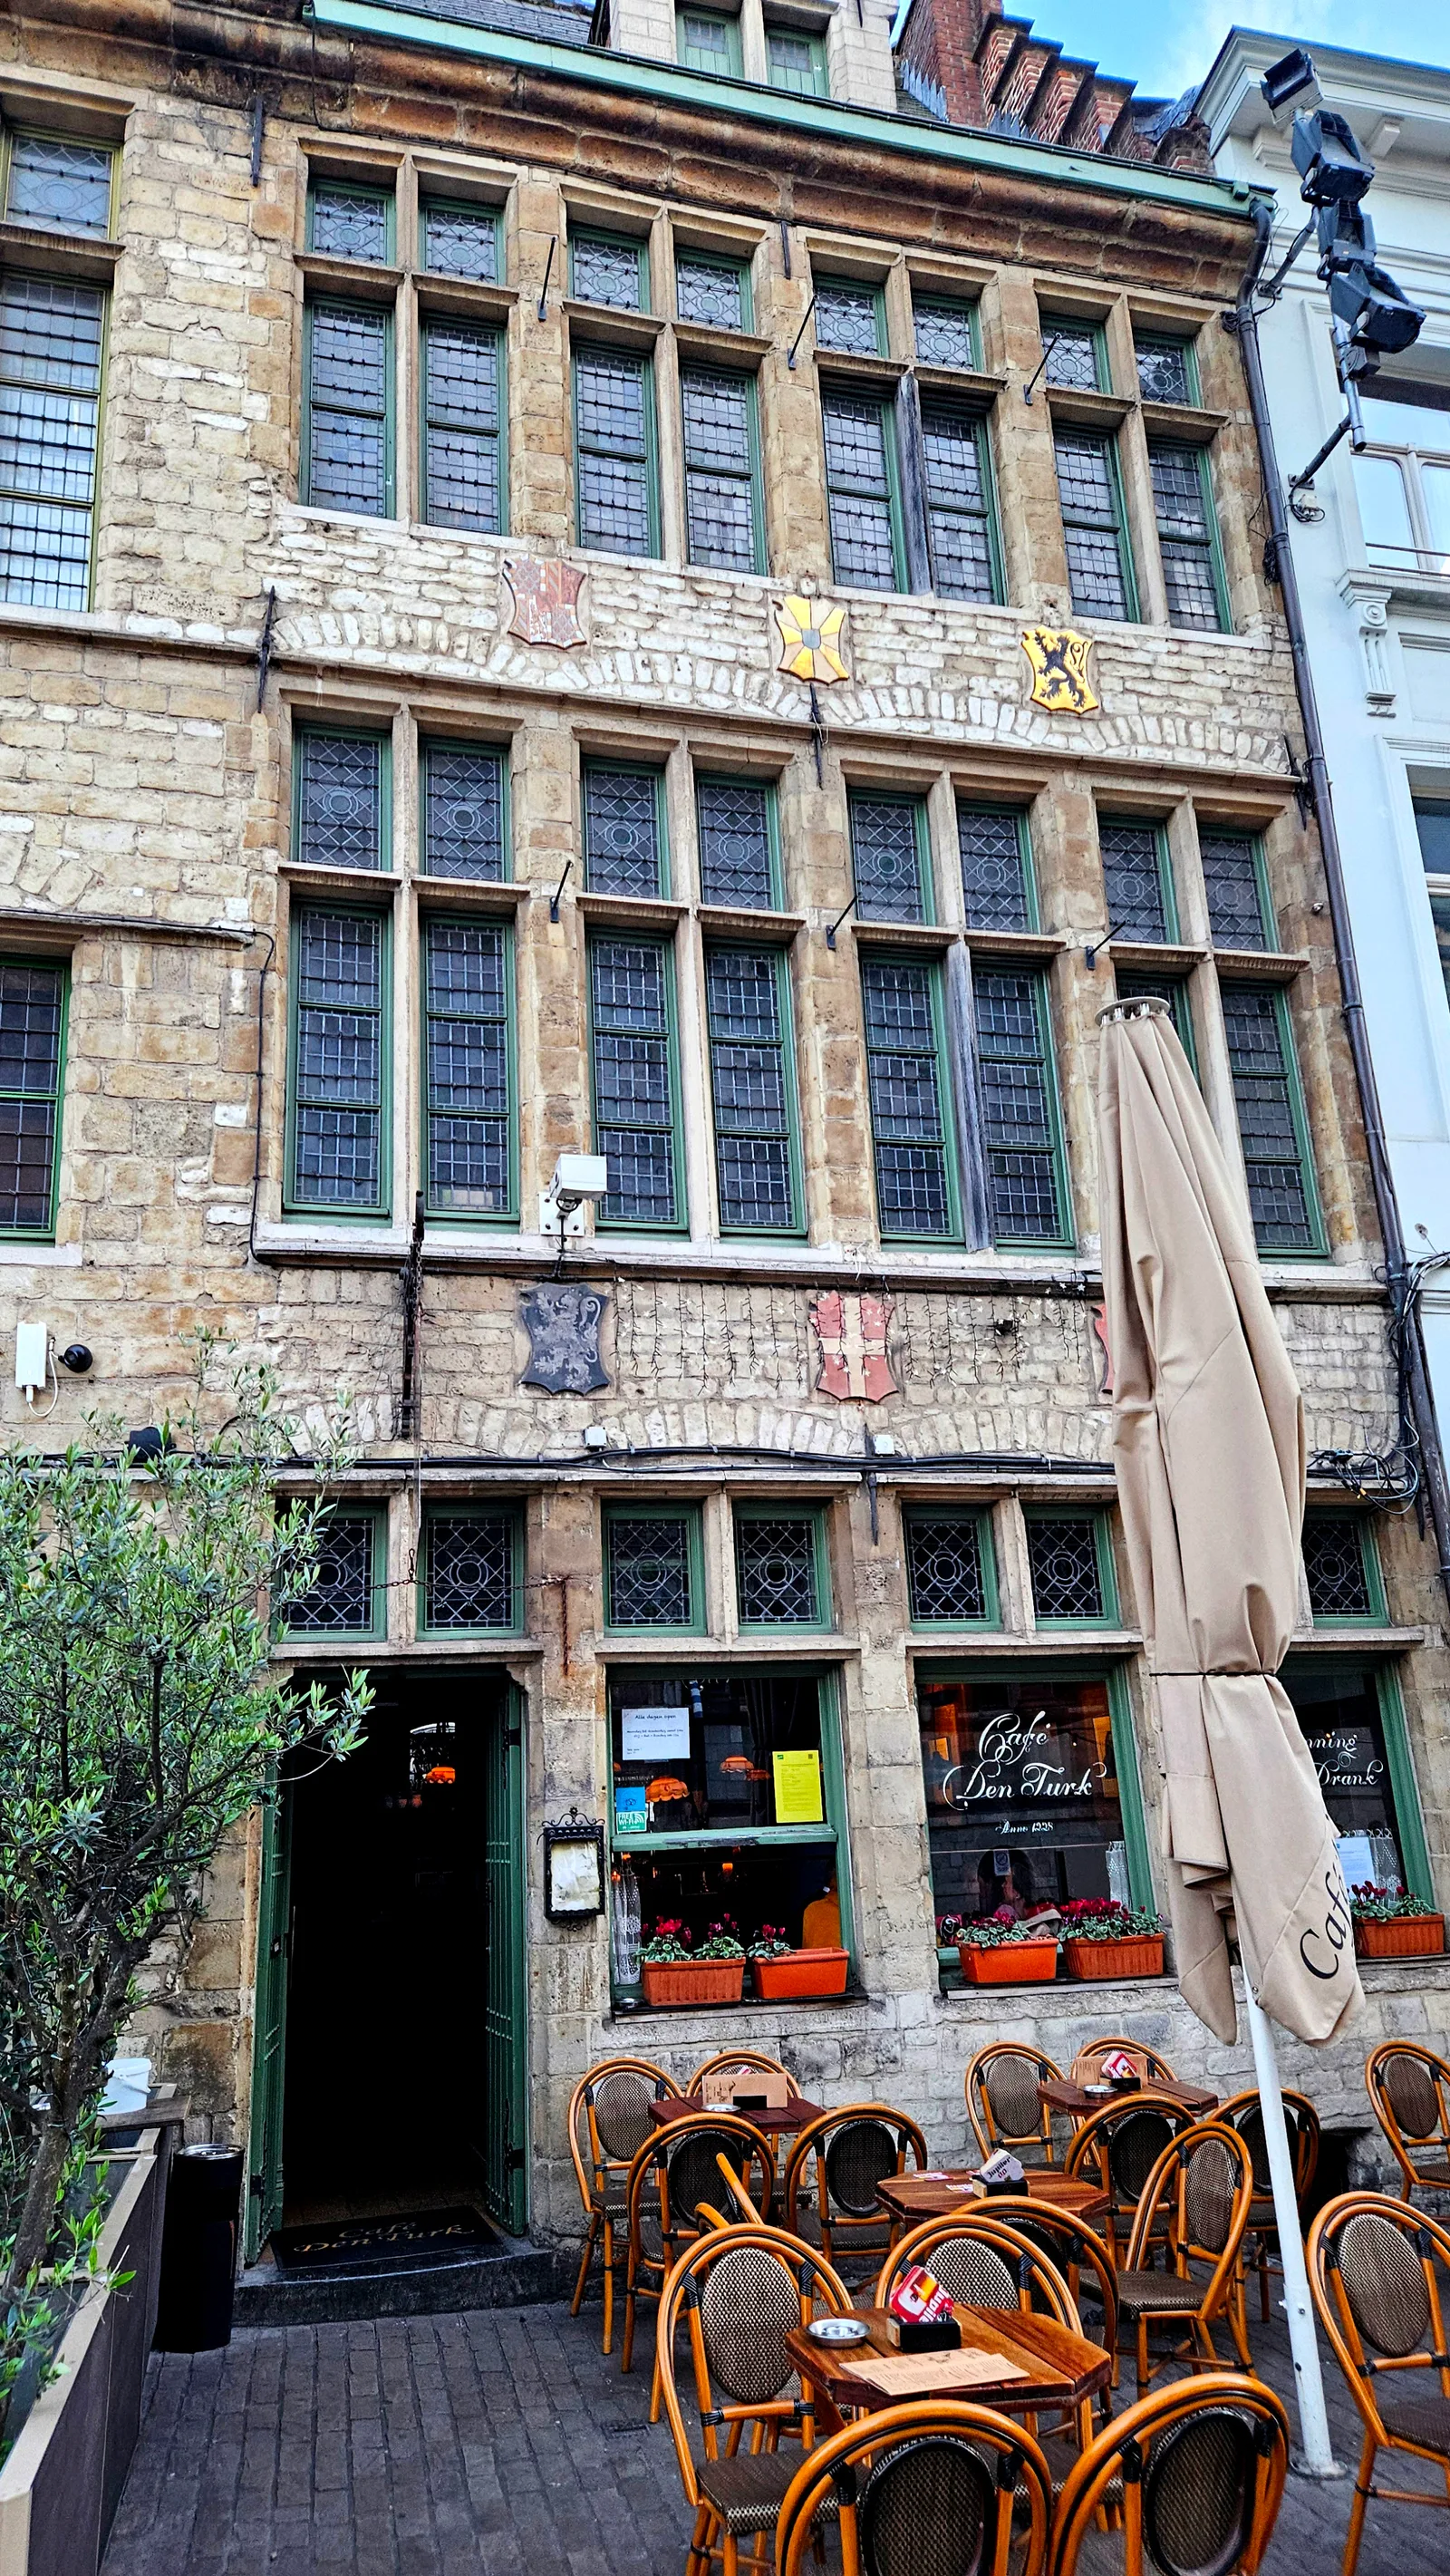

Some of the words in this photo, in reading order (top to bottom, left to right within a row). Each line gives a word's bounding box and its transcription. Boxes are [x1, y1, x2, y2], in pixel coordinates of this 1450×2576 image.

[979, 1710, 1051, 1765] Café
[942, 1761, 1015, 1811] Den
[1020, 1761, 1107, 1798] Turk
[1313, 1759, 1384, 1786] Drank
[994, 1818, 1029, 1835] Anno
[1031, 1821, 1054, 1833] 1228
[986, 2155, 1011, 2180] Jupiler
